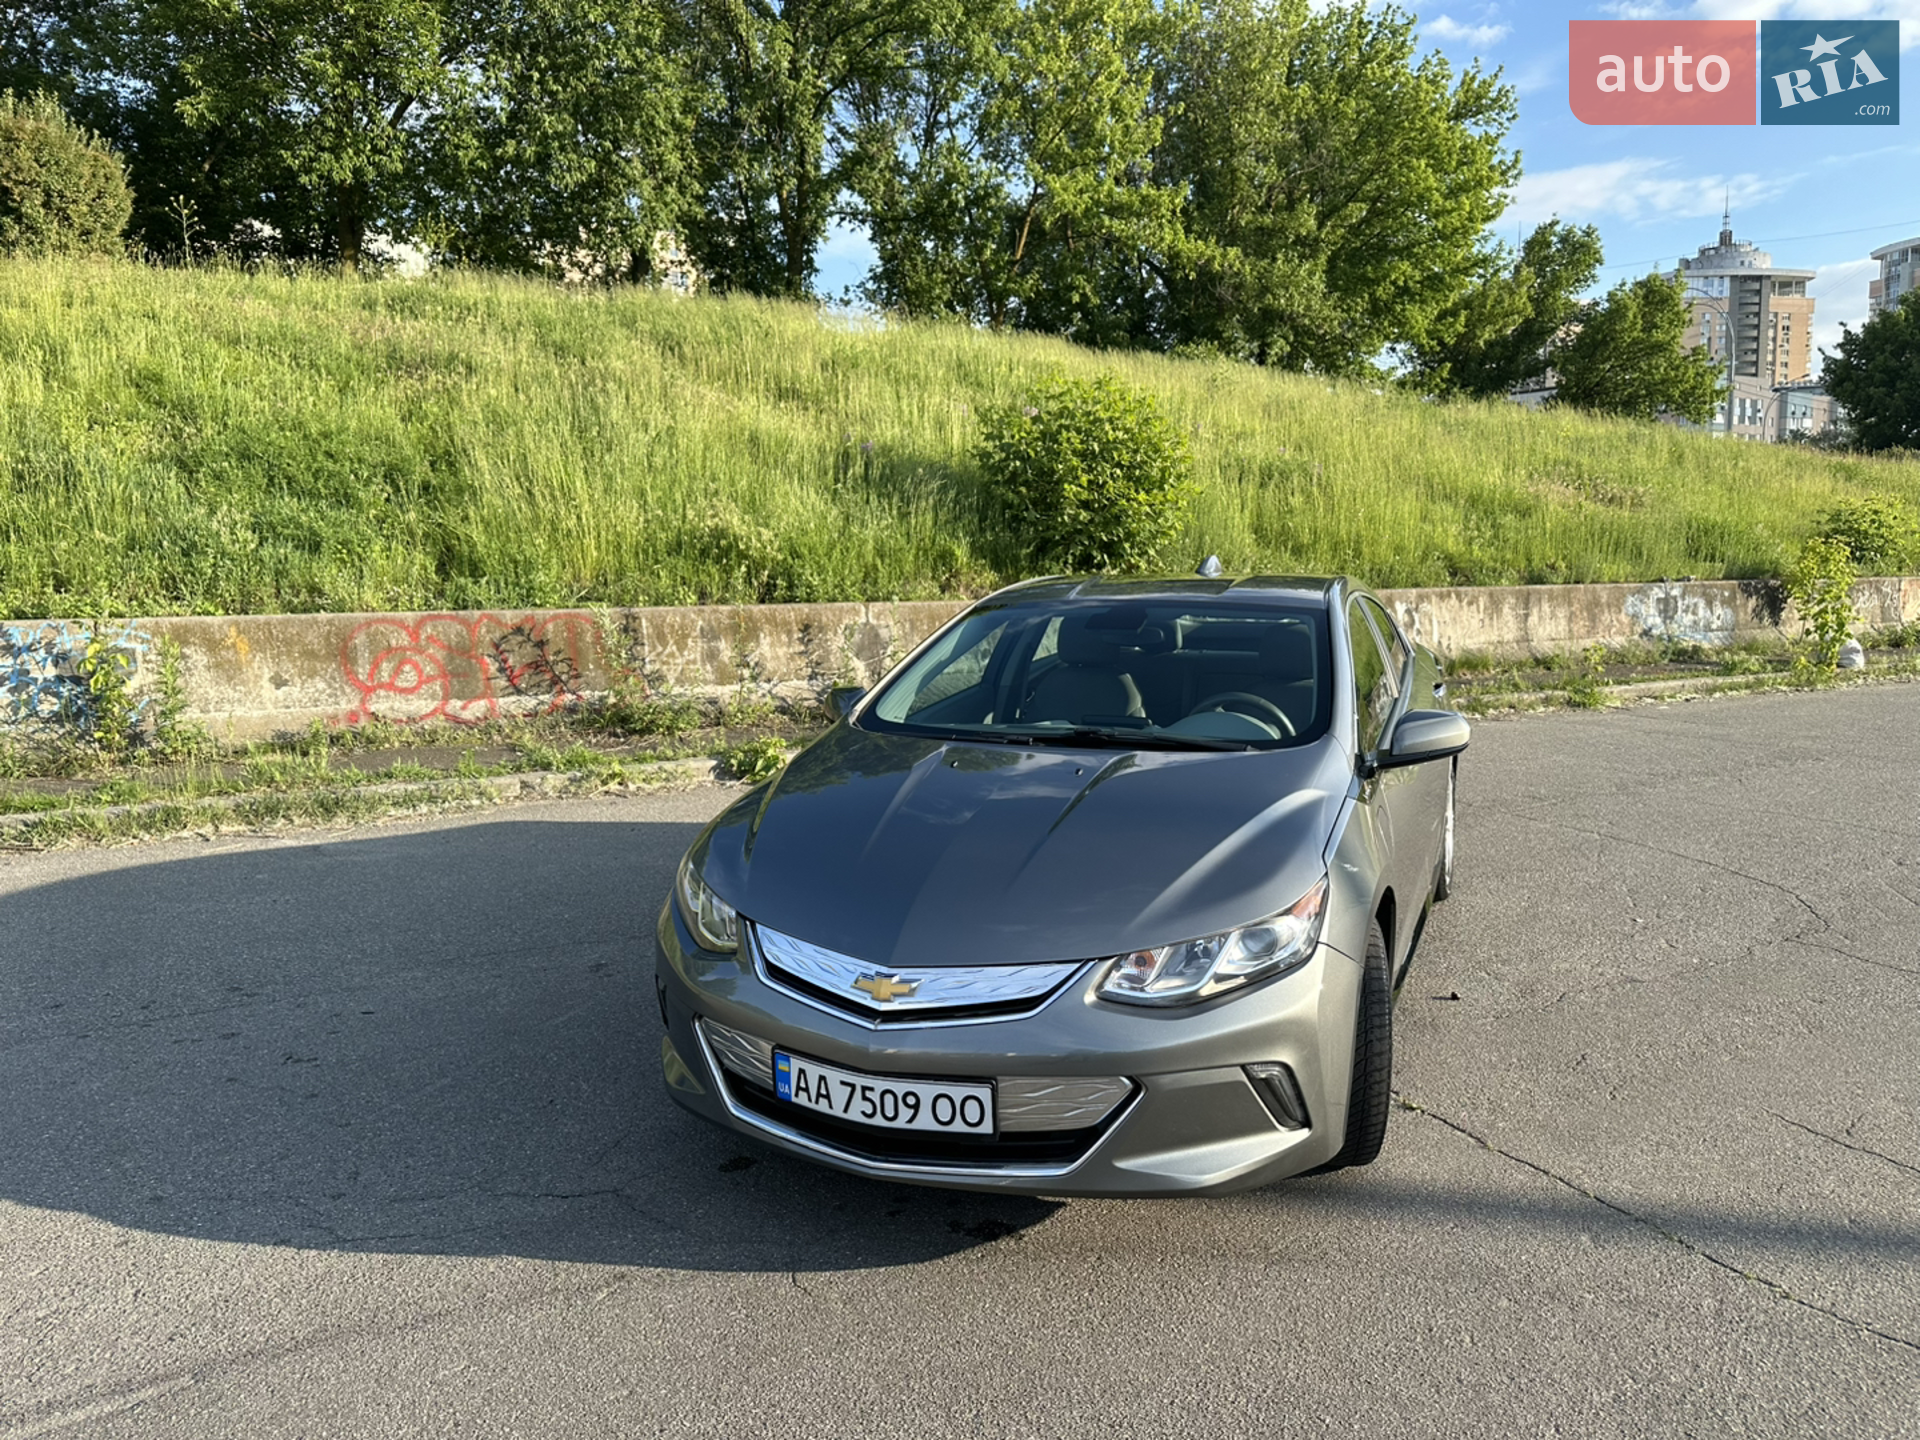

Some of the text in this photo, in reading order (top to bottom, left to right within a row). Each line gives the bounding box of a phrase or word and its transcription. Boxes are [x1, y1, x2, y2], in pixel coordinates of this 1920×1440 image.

[778, 1082, 790, 1096] UA
[794, 1067, 985, 1128] AA 7509 OO
